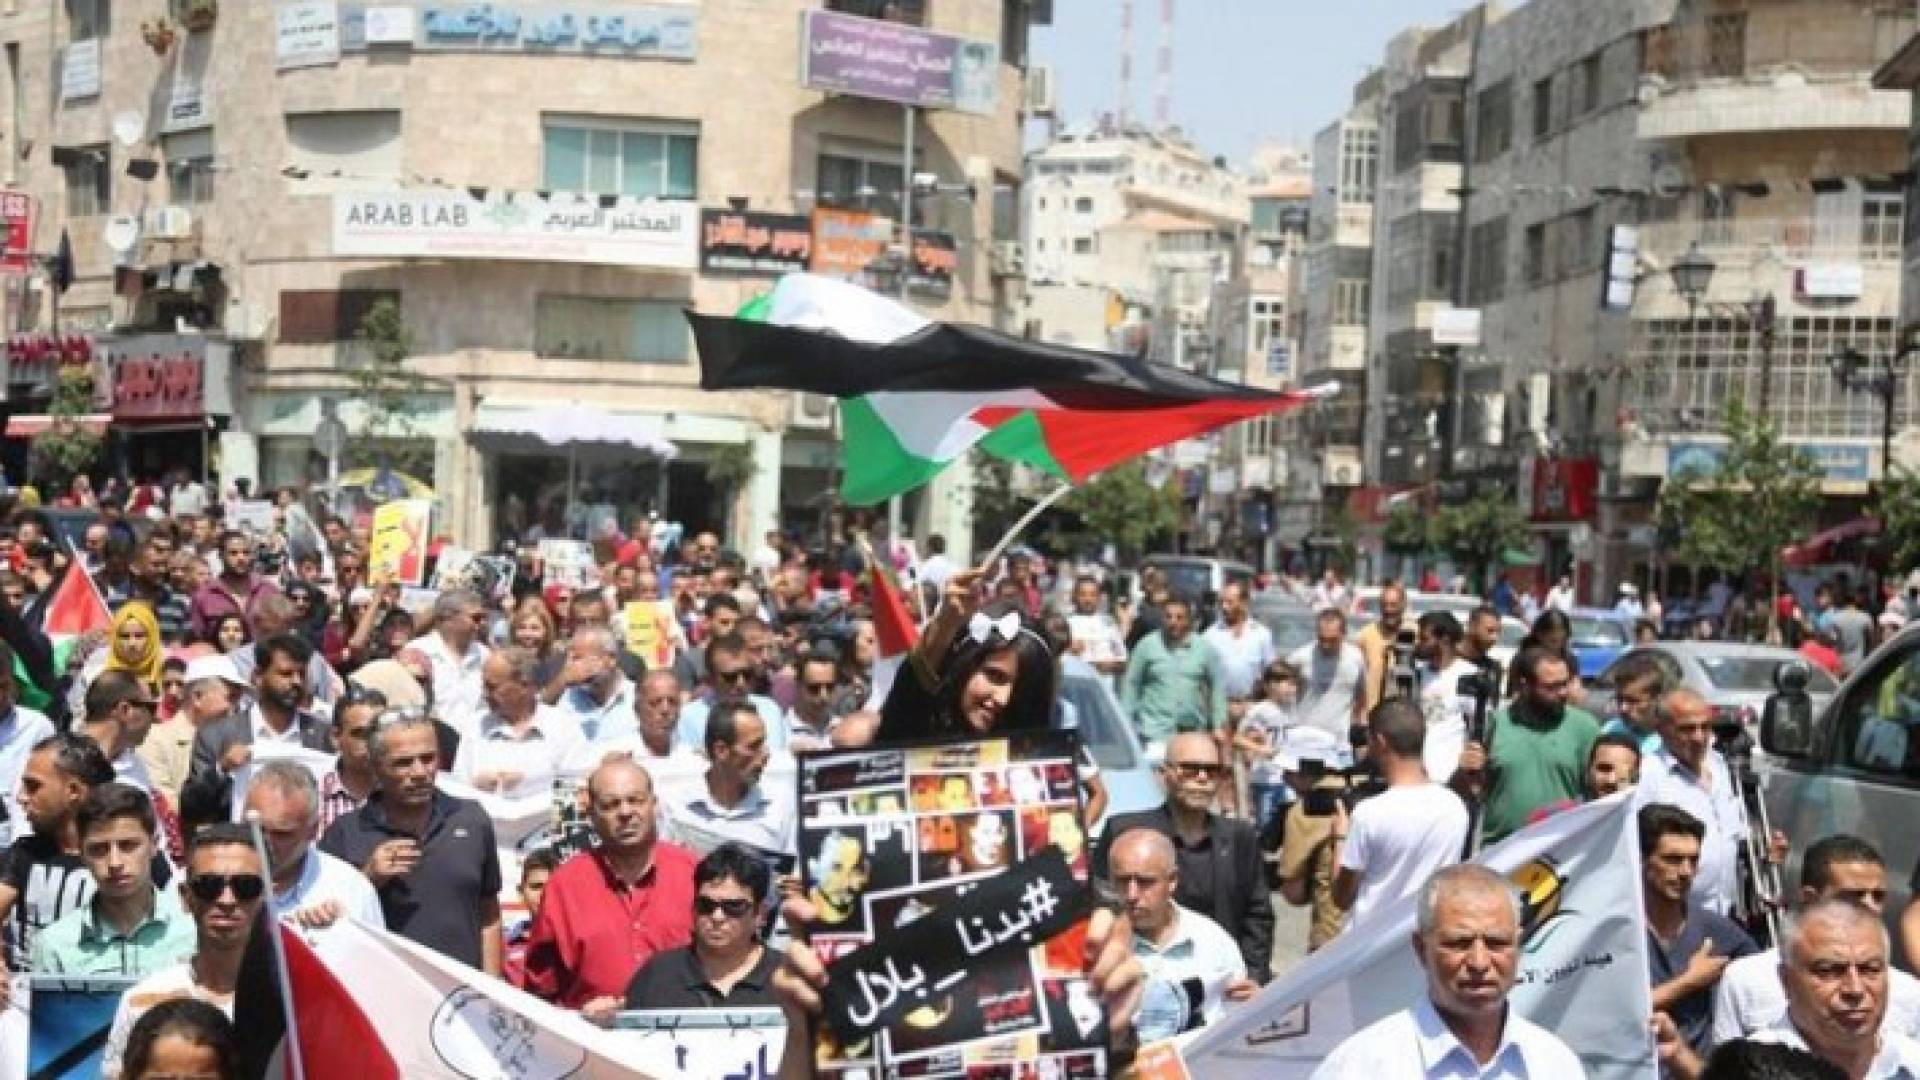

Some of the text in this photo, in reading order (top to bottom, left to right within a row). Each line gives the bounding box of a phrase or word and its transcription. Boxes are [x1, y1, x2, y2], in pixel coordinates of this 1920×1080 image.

[347, 203, 469, 228] ARAB LAB
[610, 213, 682, 232] المختبر
